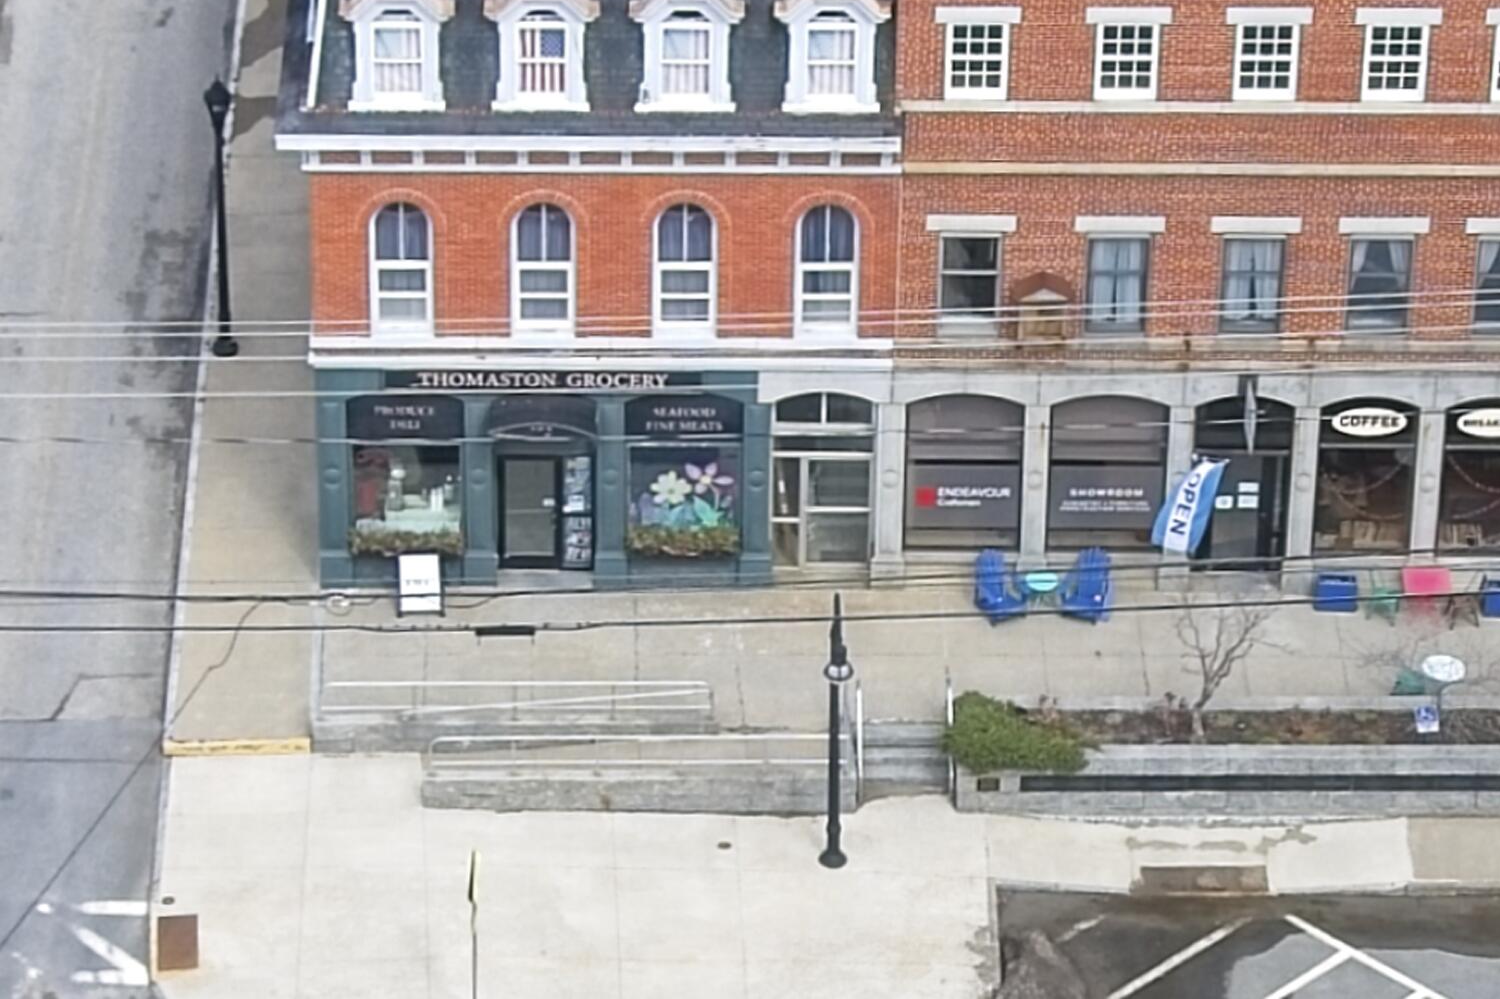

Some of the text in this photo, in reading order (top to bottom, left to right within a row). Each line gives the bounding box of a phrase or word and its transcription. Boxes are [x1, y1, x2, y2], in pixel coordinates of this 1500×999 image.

[416, 372, 669, 389] THOMASTON GROCERY
[652, 407, 716, 418] SEAFOOD
[645, 420, 724, 432] FINE MEATS
[1339, 415, 1401, 428] COFFEE
[937, 487, 1011, 498] ENDEAVOUR
[1069, 488, 1144, 498] SHOWROOM
[1169, 473, 1202, 536] OPEN
